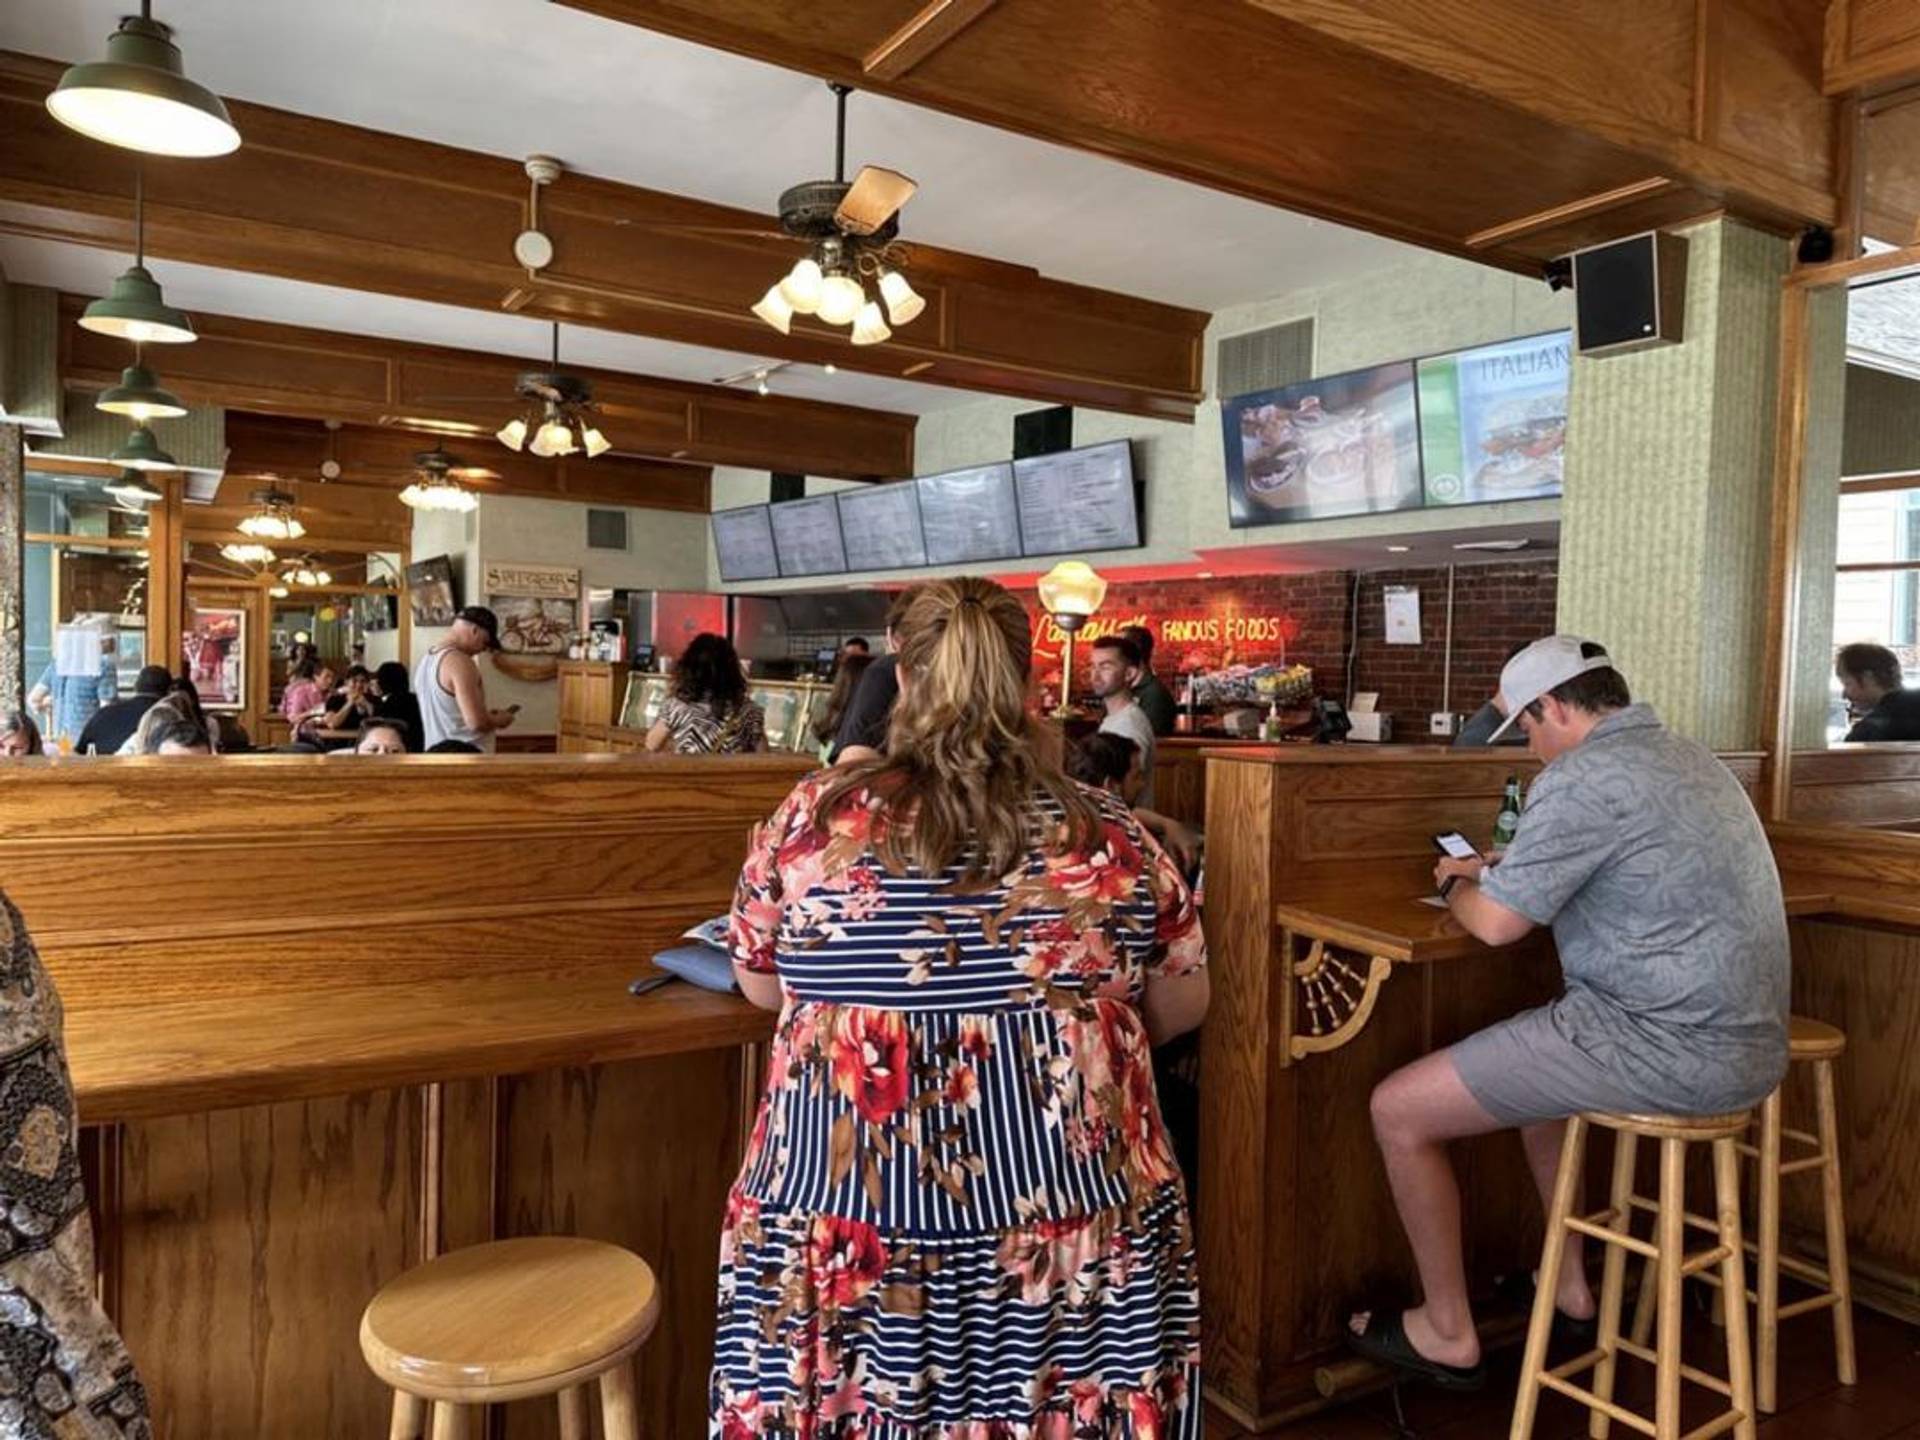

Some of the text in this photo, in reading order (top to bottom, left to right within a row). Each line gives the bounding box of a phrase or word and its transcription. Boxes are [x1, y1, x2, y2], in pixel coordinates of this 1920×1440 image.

[1481, 344, 1568, 380] ITALIAN
[1161, 619, 1218, 641] FAMOUS
[1225, 617, 1279, 641] FOODS
